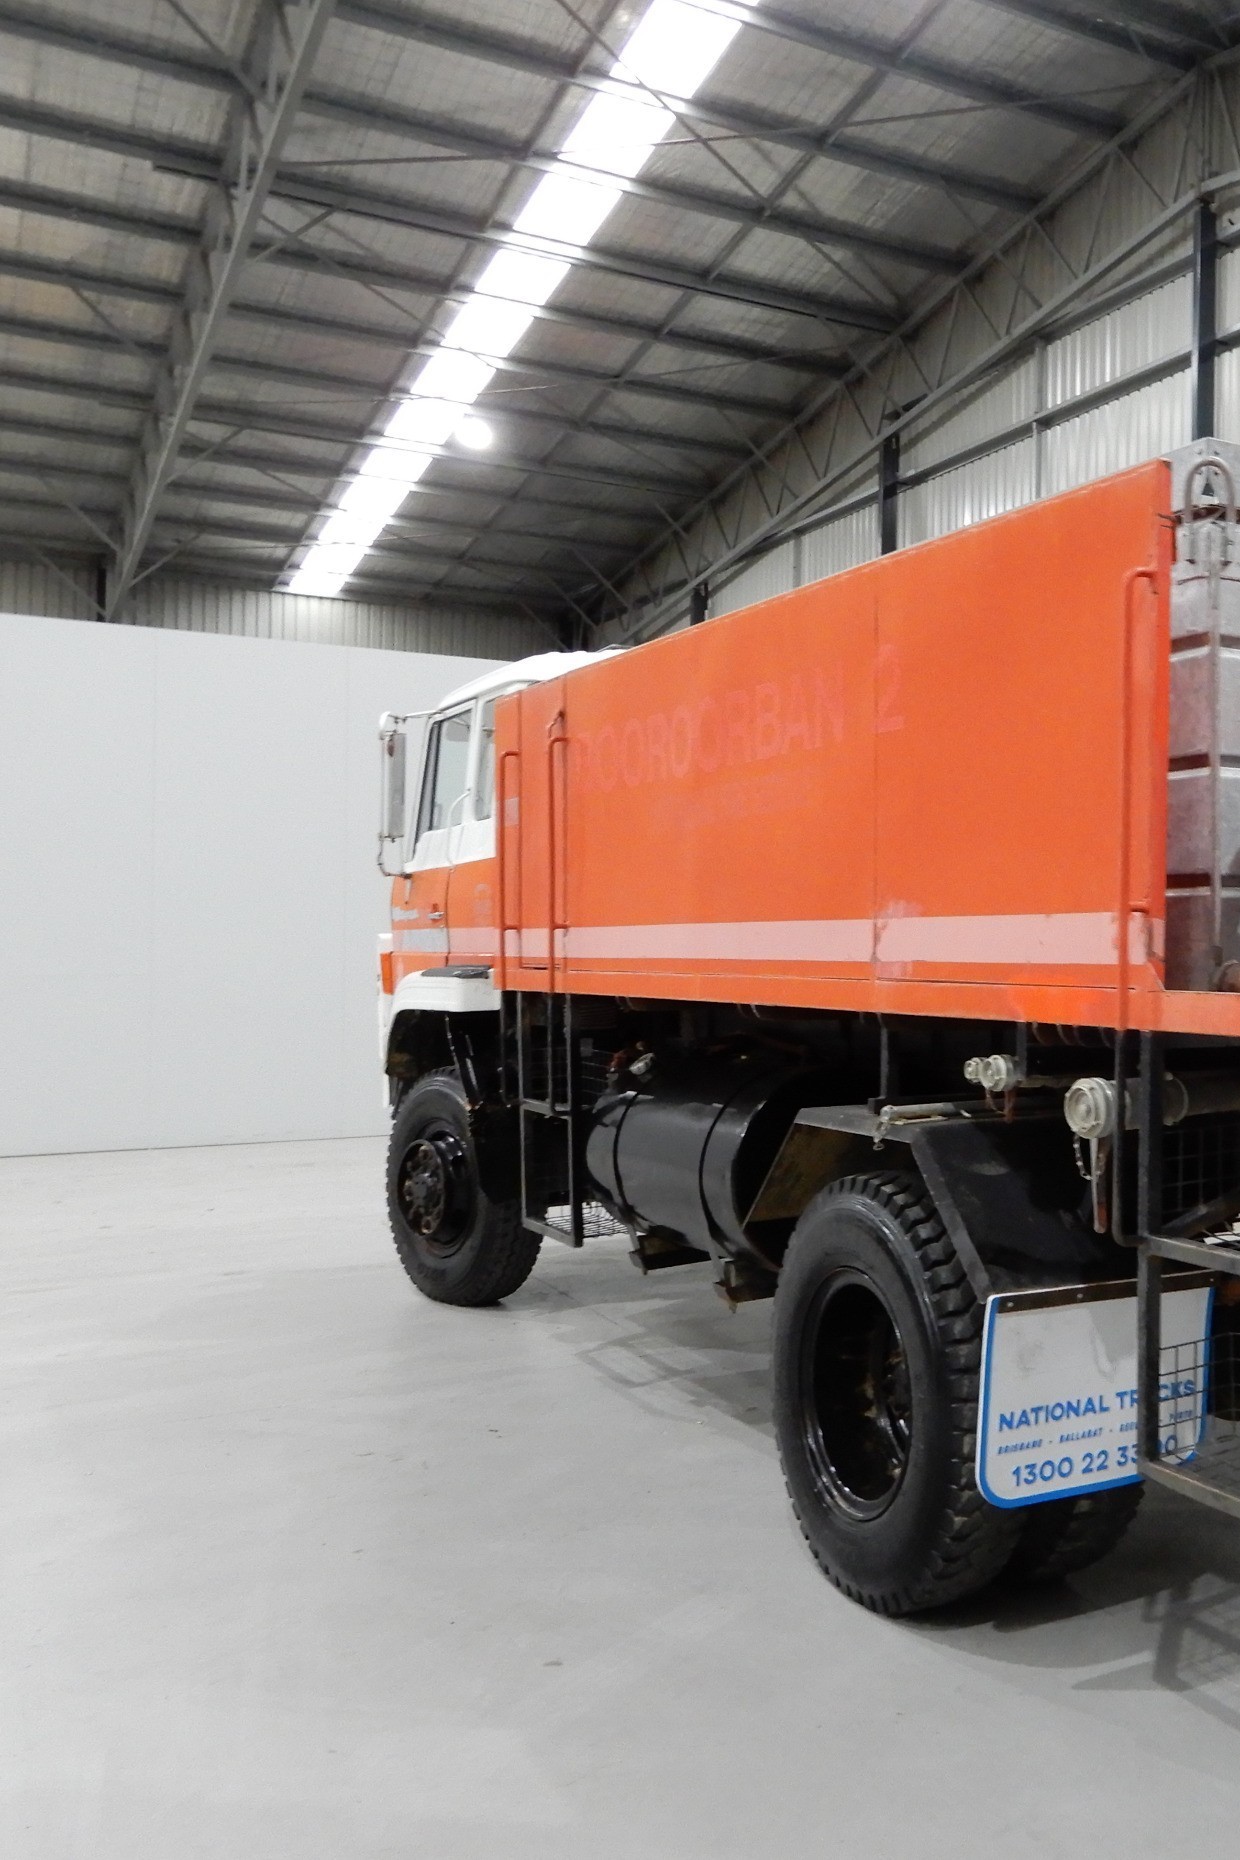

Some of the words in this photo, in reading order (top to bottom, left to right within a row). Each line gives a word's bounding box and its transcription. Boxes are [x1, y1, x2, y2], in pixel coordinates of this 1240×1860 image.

[998, 1395, 1111, 1432] NATIONAL
[1115, 1379, 1195, 1410] TRCKS
[1012, 1456, 1074, 1487] 1300
[1081, 1448, 1110, 1475] 22
